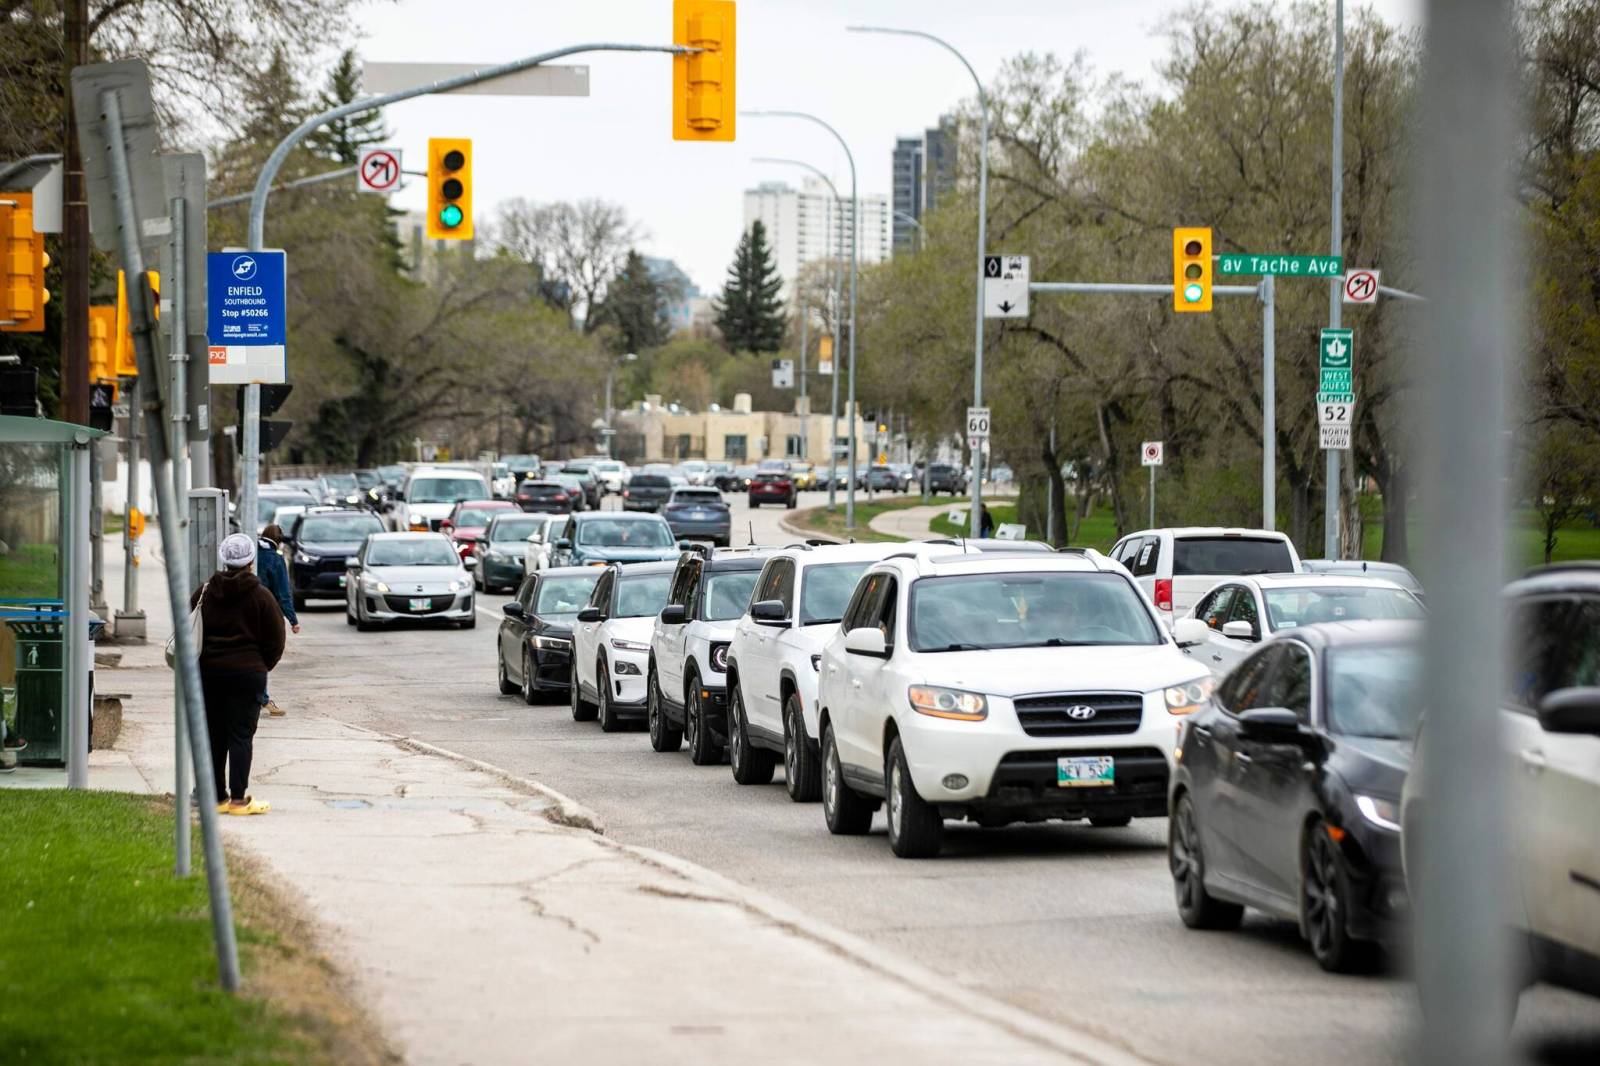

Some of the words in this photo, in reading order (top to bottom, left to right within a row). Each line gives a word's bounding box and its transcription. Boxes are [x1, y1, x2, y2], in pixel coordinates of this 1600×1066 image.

[1223, 258, 1242, 272] av
[1250, 257, 1299, 273] Tache
[1308, 258, 1338, 274] Ave
[228, 286, 263, 296] ENFIELD
[224, 298, 267, 306] SOUTHBOUND
[222, 309, 239, 318] Stop
[241, 309, 269, 317] #50266
[209, 351, 226, 360] FX2
[1324, 371, 1348, 380] WEST
[1321, 381, 1350, 390] OUEST
[1325, 406, 1346, 421] 52
[970, 418, 988, 432] 60
[1322, 428, 1349, 436] NORTH
[1324, 438, 1347, 446] NORD
